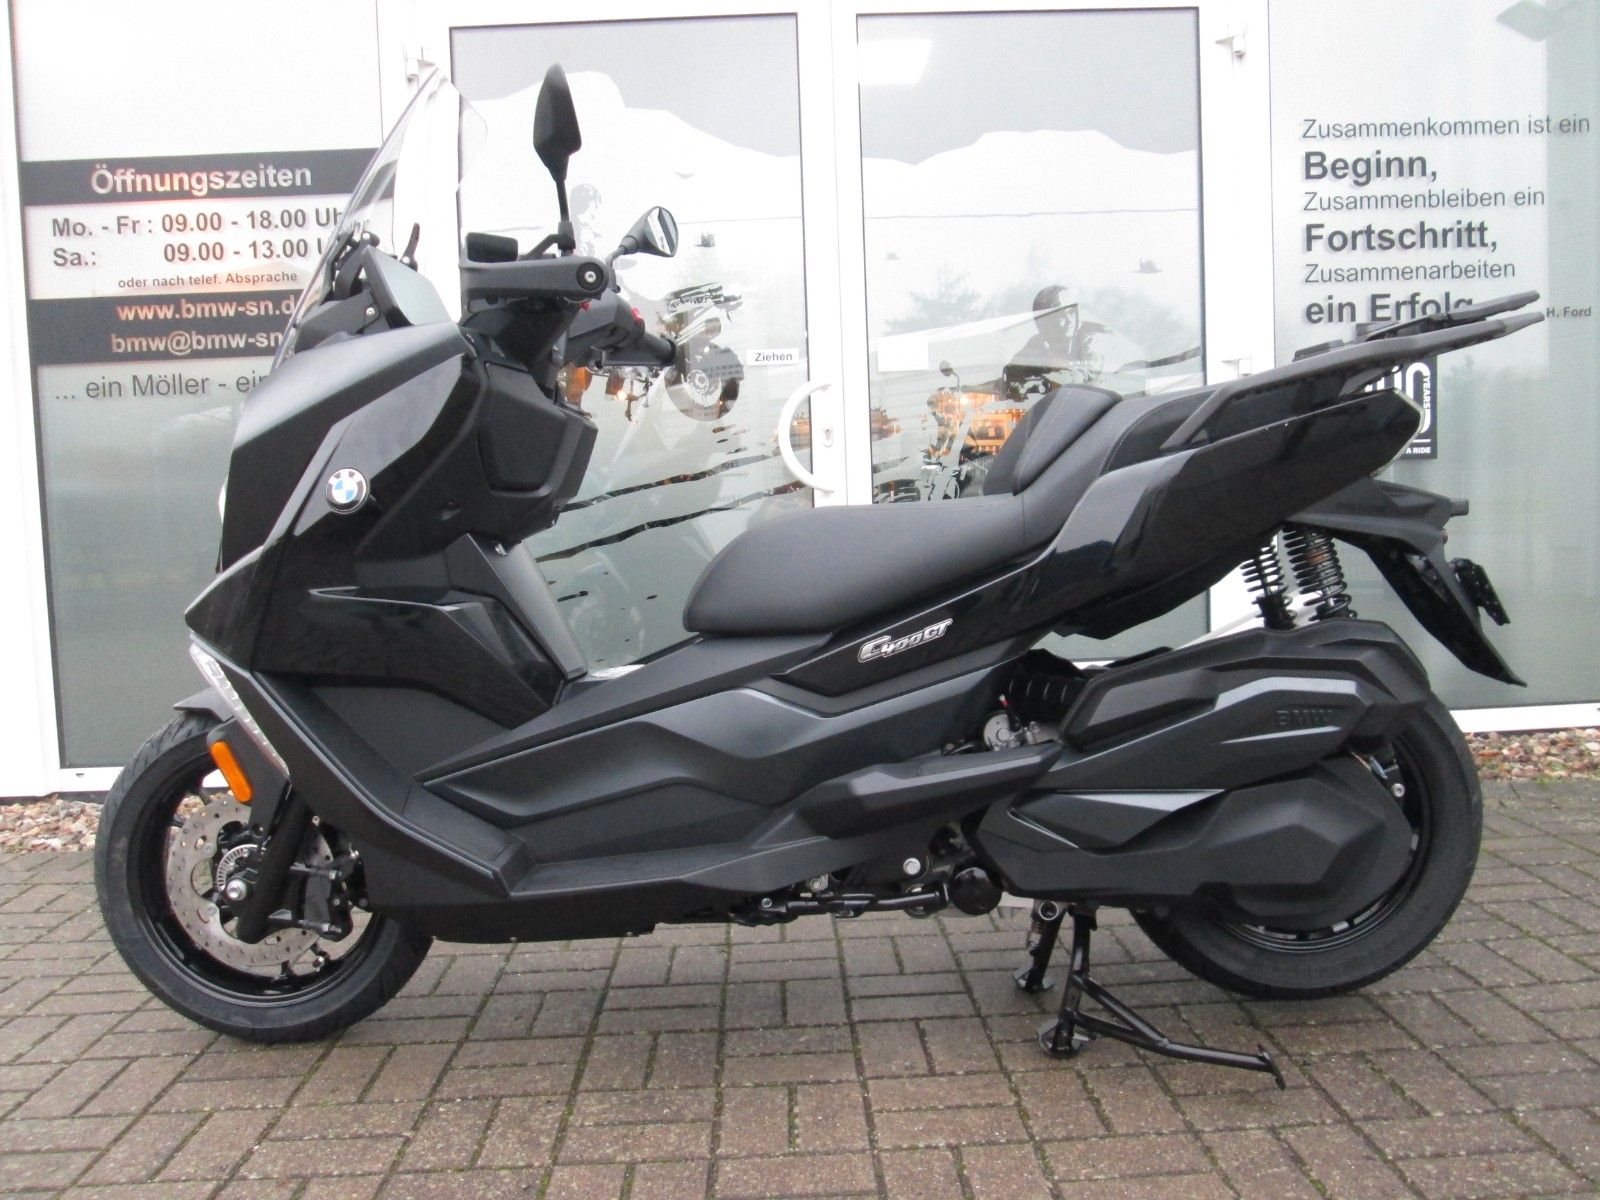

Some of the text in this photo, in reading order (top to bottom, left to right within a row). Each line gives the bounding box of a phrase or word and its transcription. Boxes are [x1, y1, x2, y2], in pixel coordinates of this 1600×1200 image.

[1302, 113, 1590, 139] Zusammenkommen ist ein
[91, 163, 312, 196] Öffnungszeiten
[1305, 150, 1438, 187] Beginn,
[1303, 187, 1545, 211] Zusammenbleiben ein
[52, 217, 93, 237] Mo.
[161, 211, 222, 233] 09.00
[246, 208, 306, 230] 18.00
[315, 207, 342, 228] Uh
[1305, 219, 1498, 253] Fortschritt,
[53, 247, 96, 267] Sa.:
[163, 242, 224, 263] 09.00
[248, 238, 308, 260] 13.00
[118, 271, 298, 289] oder nach telef. Absprache
[1303, 259, 1516, 283] Zusammenarbeiten
[116, 294, 295, 321] www.bmw-sn.d
[1305, 295, 1356, 324] ein
[1546, 305, 1592, 318] H. Ford
[111, 331, 284, 356] bmw@bmw-sn
[754, 351, 793, 362] Ziehen
[86, 376, 122, 399] ein
[132, 373, 210, 397] Möller
[1423, 375, 1431, 409] YEARS
[1413, 446, 1431, 454] RIDE
[1276, 708, 1334, 726] BMW
